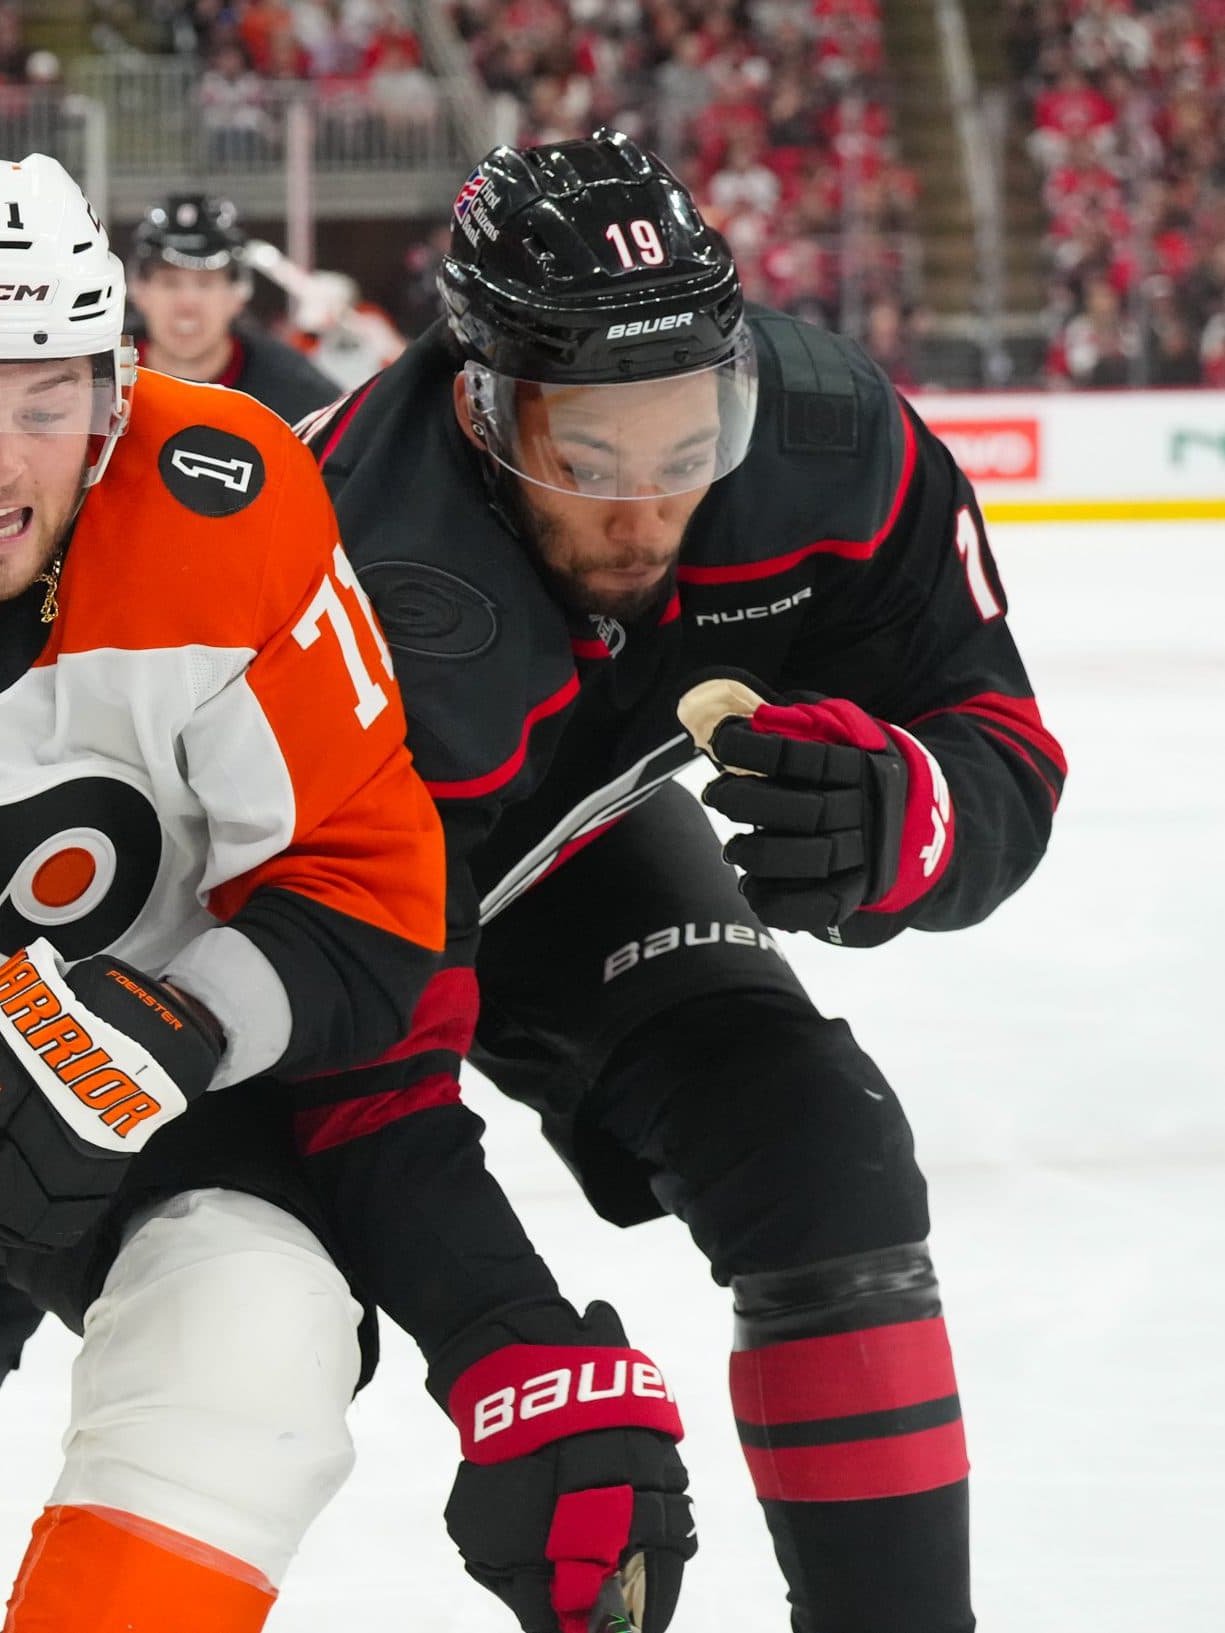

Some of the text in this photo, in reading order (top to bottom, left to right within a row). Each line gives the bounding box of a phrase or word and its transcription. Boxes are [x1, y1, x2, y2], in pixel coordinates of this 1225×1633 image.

[480, 180, 501, 209] First
[462, 213, 480, 249] Bank
[471, 197, 500, 241] Citizens
[605, 219, 665, 268] 19
[171, 449, 254, 493] 1
[696, 586, 812, 626] NUCOR
[105, 970, 183, 1031] FOERSTER
[473, 1360, 675, 1443] BAUE
